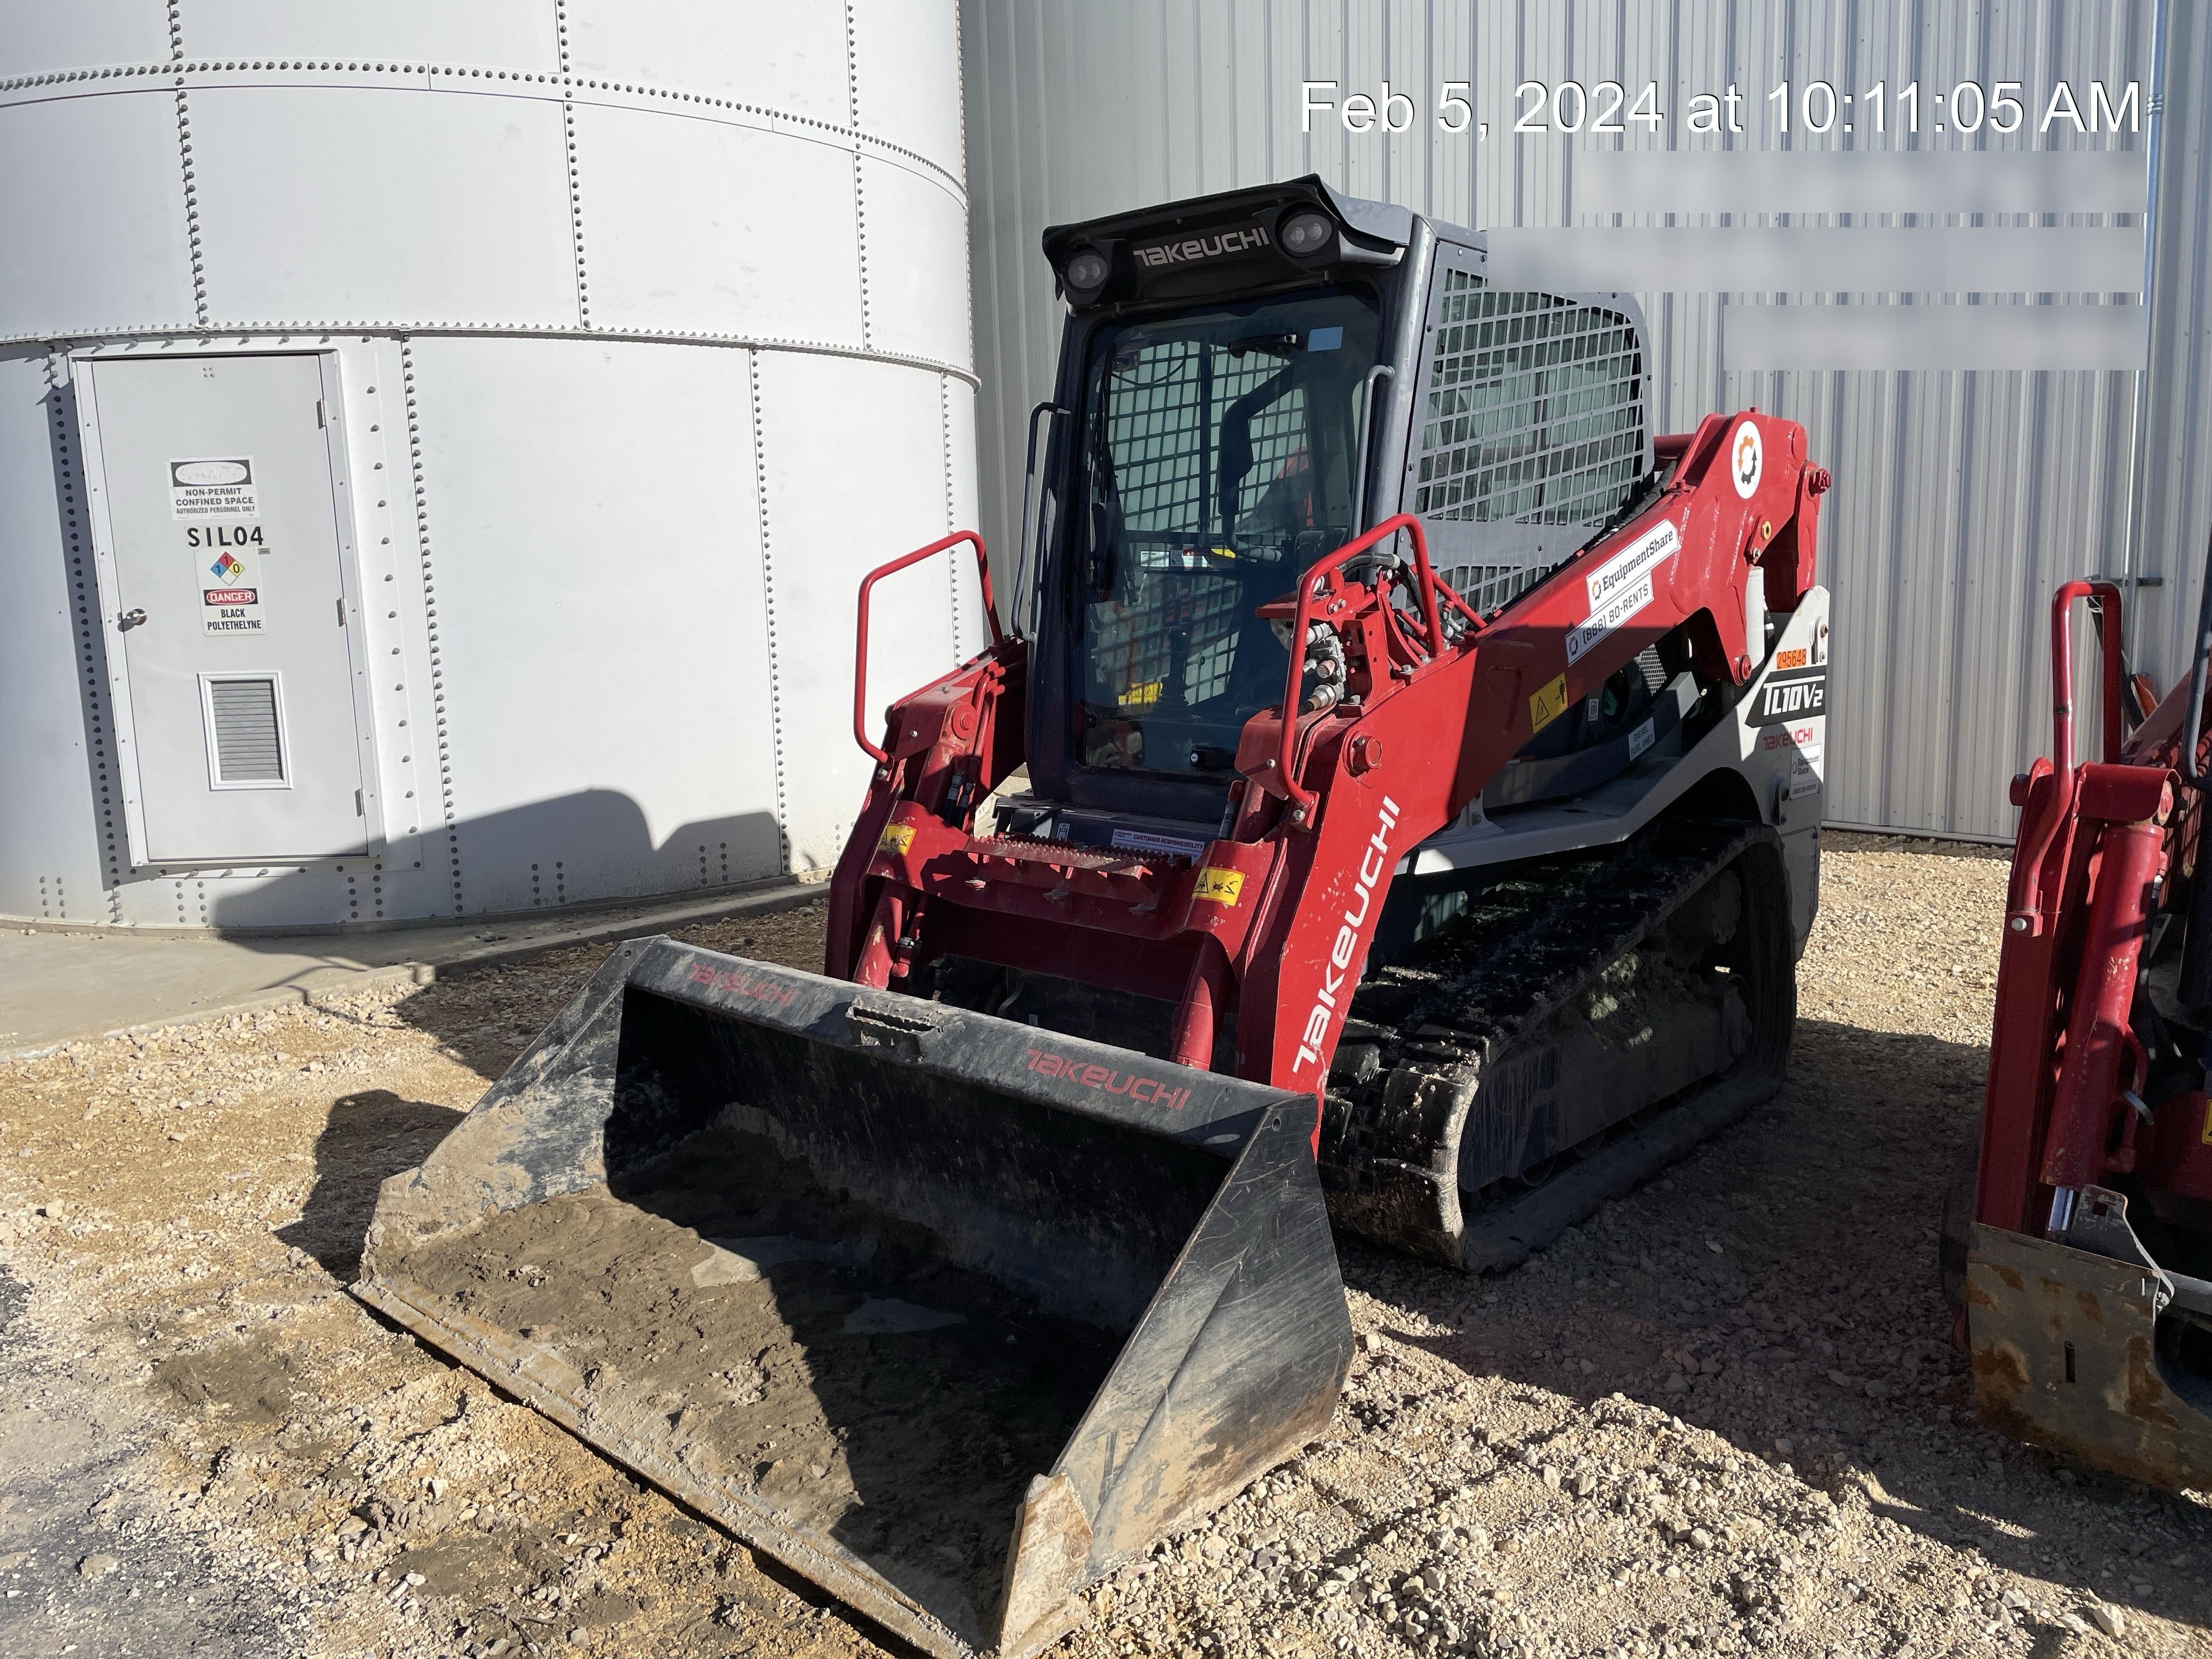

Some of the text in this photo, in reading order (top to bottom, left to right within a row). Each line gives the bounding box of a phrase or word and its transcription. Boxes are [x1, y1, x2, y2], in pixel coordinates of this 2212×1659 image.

[185, 488, 241, 496] NON-PERMIT
[223, 555, 229, 565] 1
[1602, 530, 1673, 591] EquipmentShare
[215, 563, 240, 574] 1 0
[210, 592, 252, 602] DANGER
[221, 608, 246, 618] BLACK
[1582, 583, 1649, 645] (888) 80-RENTS
[207, 620, 262, 630] POLYETHELYNE
[1777, 648, 1807, 669] 295648
[1133, 834, 1203, 849] CUSTOMER RESPONSIBILITY
